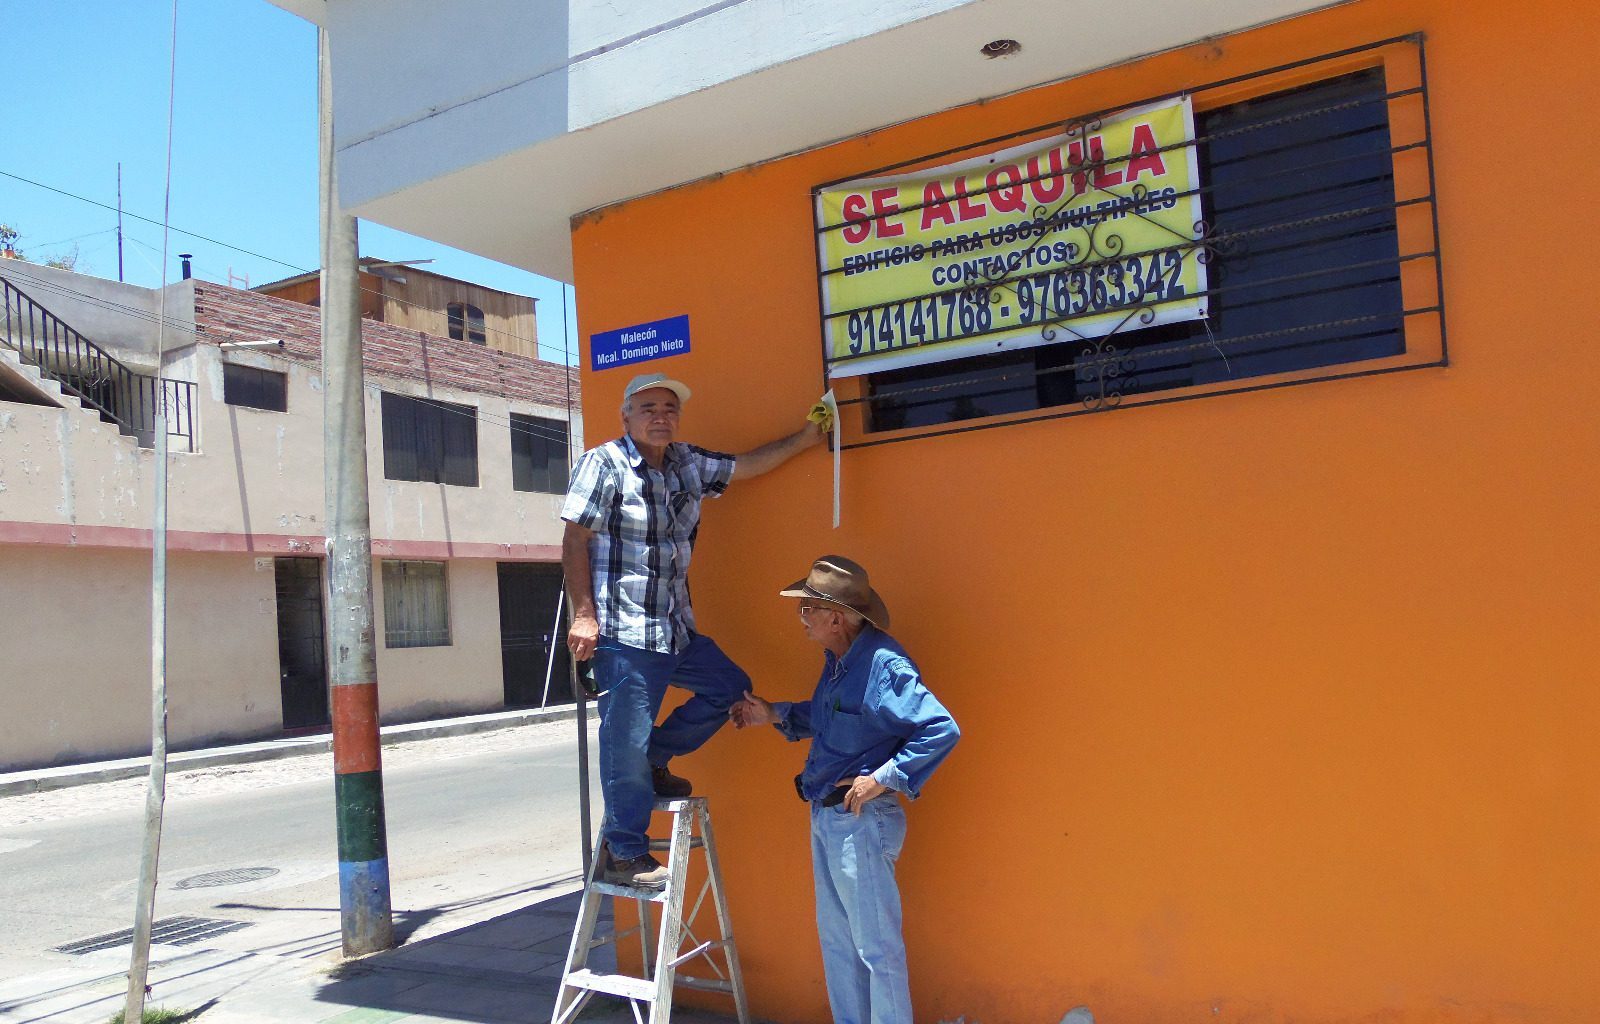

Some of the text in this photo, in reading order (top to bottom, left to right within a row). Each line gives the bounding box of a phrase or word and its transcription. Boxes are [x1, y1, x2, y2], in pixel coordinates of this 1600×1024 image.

[842, 124, 1166, 244] SE ALQUILA
[843, 187, 1177, 276] EDIFICIO PARA USOS MULTIPLES
[620, 327, 657, 345] Malecón
[848, 287, 992, 355] 914141768
[1017, 249, 1185, 325] 976363342
[597, 338, 684, 365] Mcal. Domingo Nieto
